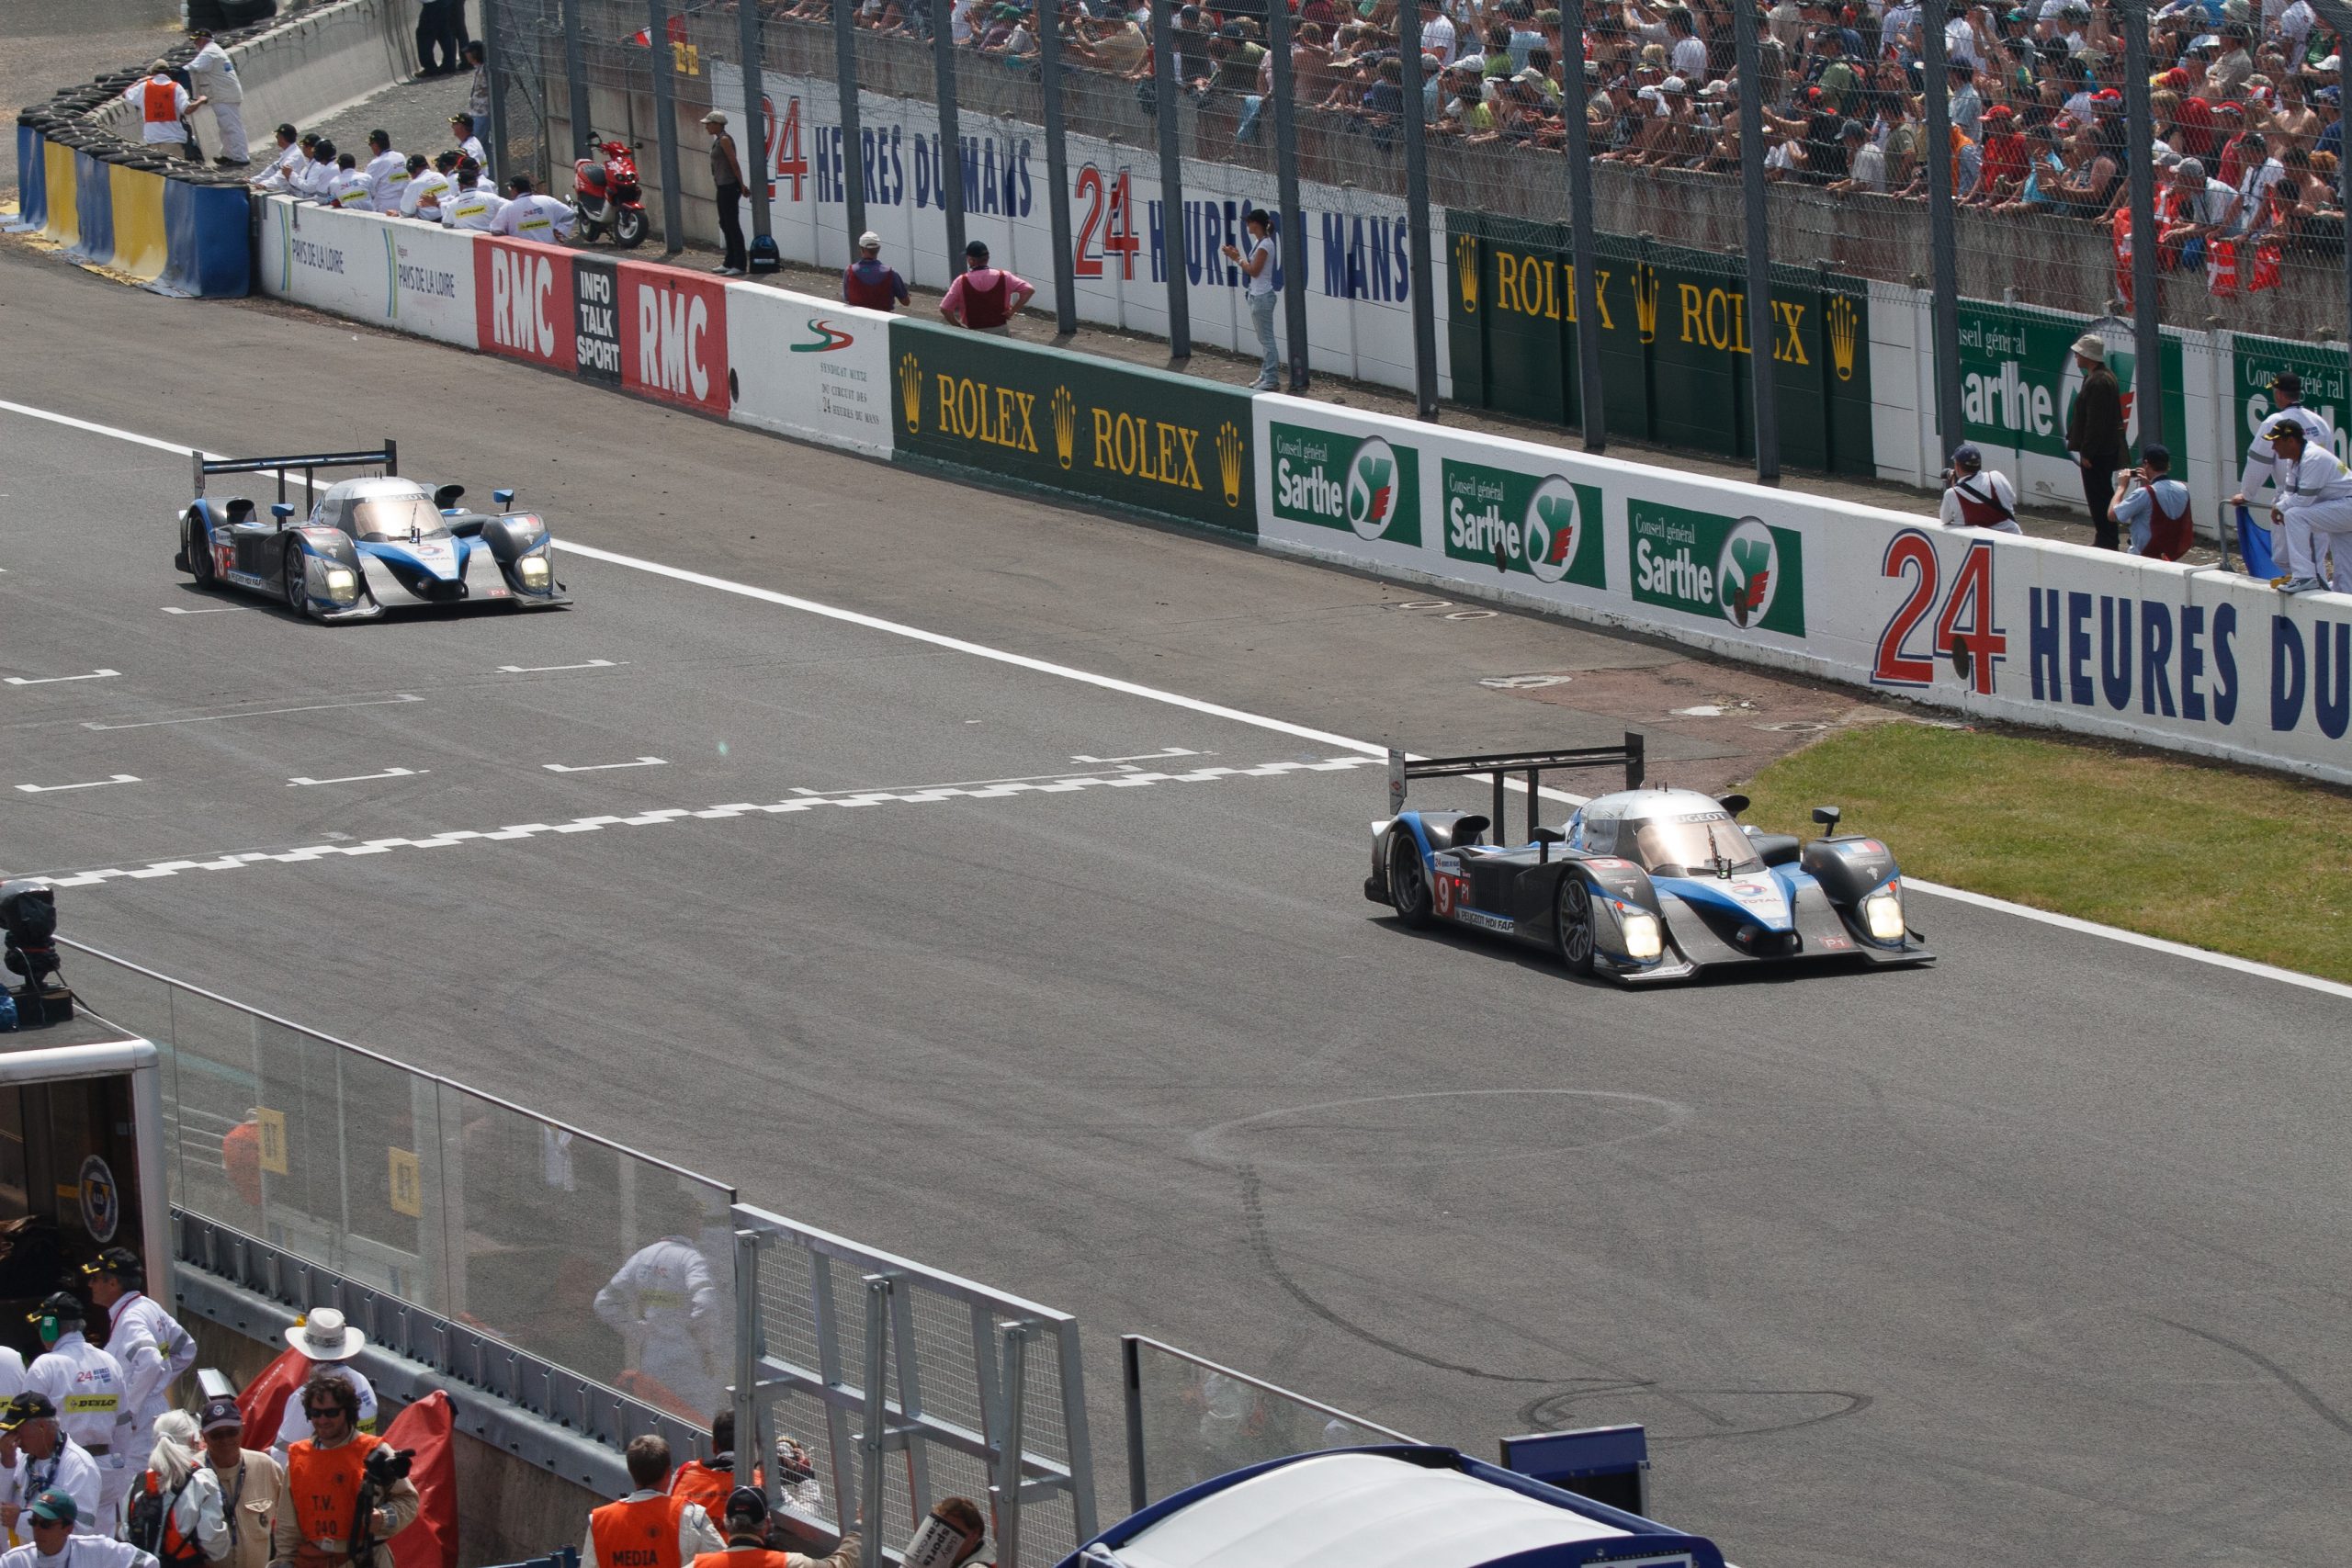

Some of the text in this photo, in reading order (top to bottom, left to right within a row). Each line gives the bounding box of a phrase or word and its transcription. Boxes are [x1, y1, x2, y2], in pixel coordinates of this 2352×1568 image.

[815, 123, 903, 207] HERES
[959, 135, 1033, 219] MANS
[1073, 162, 1139, 281] 24
[1148, 198, 1252, 288] HURES
[1322, 211, 1410, 303] MANS
[292, 238, 345, 275] PAYS DE LA LOIRE
[398, 264, 455, 298] PAYS DE LA LOIRE
[580, 271, 610, 304] INFO
[492, 247, 555, 358] RMC
[580, 304, 614, 338] TALK
[577, 335, 620, 373] SPORT
[639, 284, 709, 401] RMC
[1960, 358, 2053, 436] arthe
[936, 373, 1204, 491] ROLEX ROLEX
[1276, 434, 1328, 464] Conseil général
[1278, 457, 1343, 518] Sarthe
[1449, 472, 1504, 503] Conseil général
[1450, 497, 1521, 559] Sarthe
[1635, 513, 1695, 545] Conseil général
[218, 547, 224, 577] 8
[1636, 538, 1713, 604] Sarthe
[1870, 528, 2350, 740] 24 HEURES DU
[1674, 812, 1725, 823] UGEOT
[1439, 876, 1449, 913] 9
[1462, 883, 1469, 900] P1
[1498, 920, 1514, 931] FAP
[1825, 938, 1846, 948] P1
[76, 1371, 93, 1383] 24
[612, 1550, 659, 1567] MEDIA
[922, 1528, 951, 1566] sports
[940, 1536, 958, 1559] daily
